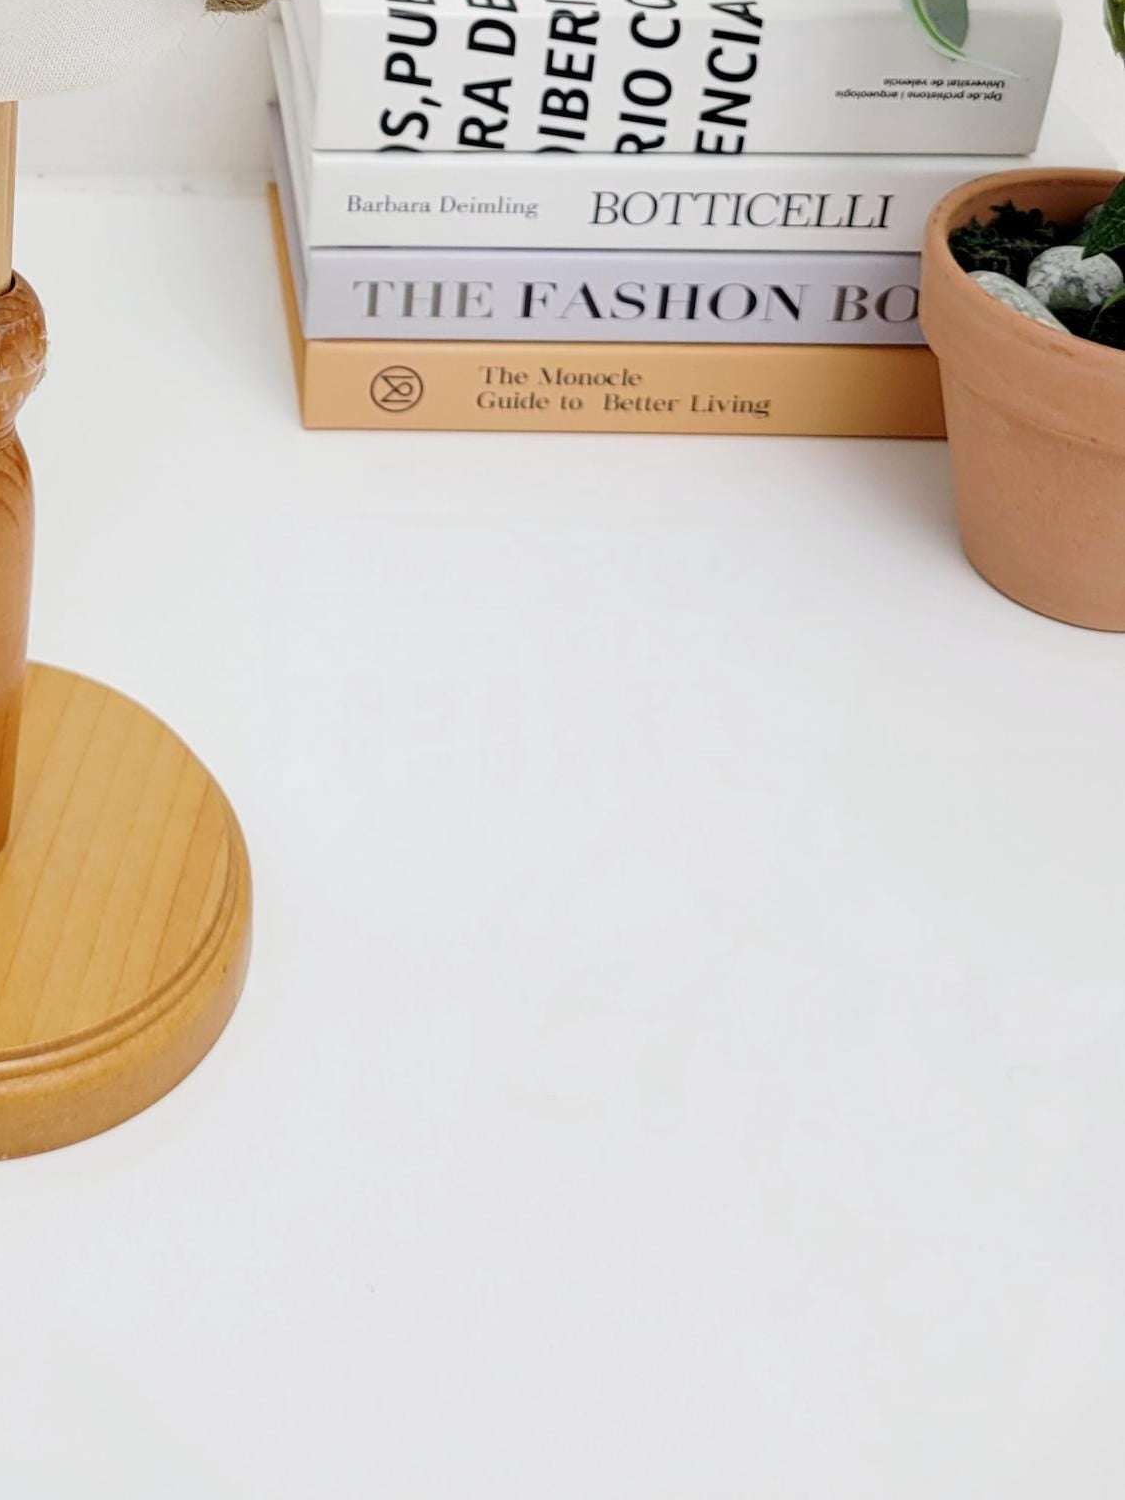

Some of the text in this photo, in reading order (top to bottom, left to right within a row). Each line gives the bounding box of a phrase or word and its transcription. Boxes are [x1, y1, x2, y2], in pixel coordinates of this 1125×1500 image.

[378, 97, 442, 152] S,
[346, 195, 539, 218] Barbara Deimling
[589, 191, 896, 228] BOTTICELLI
[352, 280, 494, 318] THE
[516, 280, 812, 322] FASHON
[478, 365, 643, 387] The Monocle
[476, 391, 771, 418] Guide to Better Living
